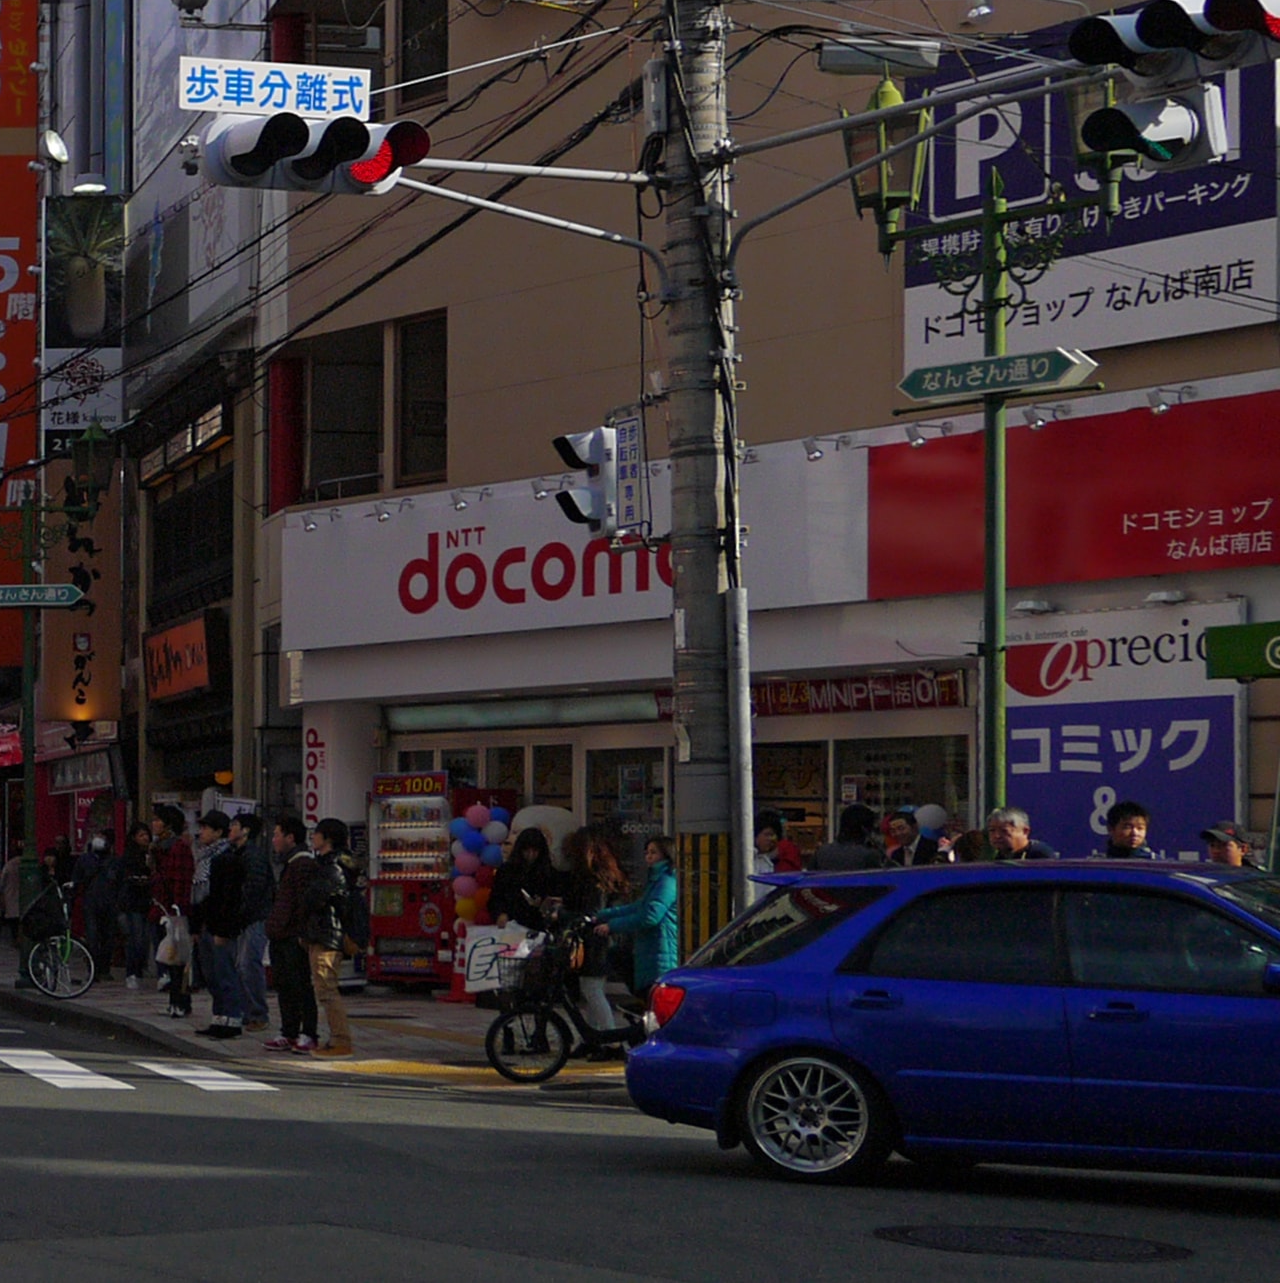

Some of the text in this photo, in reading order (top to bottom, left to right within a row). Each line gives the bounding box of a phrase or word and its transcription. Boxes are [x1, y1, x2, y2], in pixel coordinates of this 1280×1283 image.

[186, 63, 364, 114] 歩車分離式
[954, 92, 1023, 200] P
[1083, 173, 1253, 229] けきパーキング
[1105, 259, 1255, 312] なんば南店
[921, 355, 1052, 392] なんさん通り
[445, 526, 486, 550] NTT
[1122, 498, 1274, 536] ドコモショップ
[1167, 530, 1274, 562] なんば南店
[810, 680, 871, 711] MNP
[1011, 718, 1211, 775] コミック
